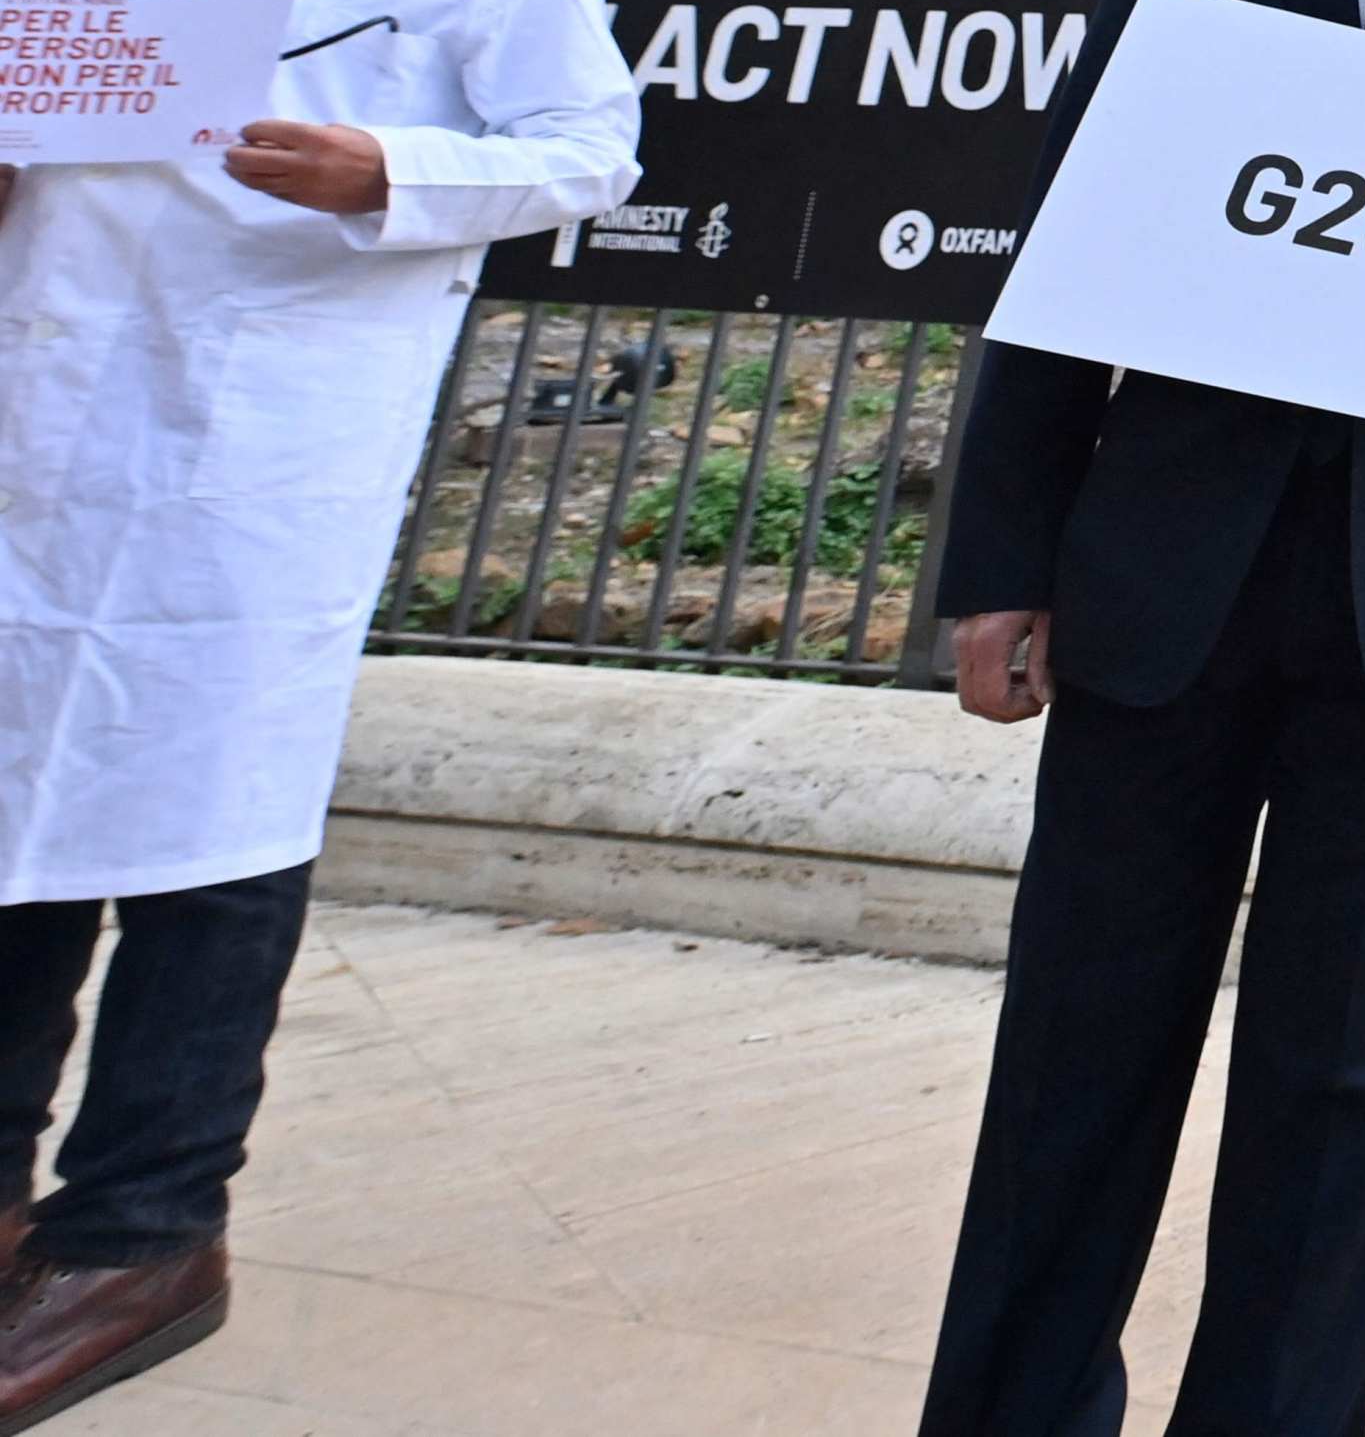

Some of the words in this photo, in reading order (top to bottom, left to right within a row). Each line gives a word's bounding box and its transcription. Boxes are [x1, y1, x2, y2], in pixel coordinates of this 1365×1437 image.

[0, 10, 72, 33] PER
[82, 10, 130, 33] LE
[0, 37, 163, 60] PERSONE
[632, 4, 852, 104] ACT
[75, 64, 147, 87] PER
[152, 64, 180, 86] IL
[0, 91, 156, 114] ROFITTO
[592, 205, 690, 232] AMNESTY
[939, 226, 1017, 255] OXFAM
